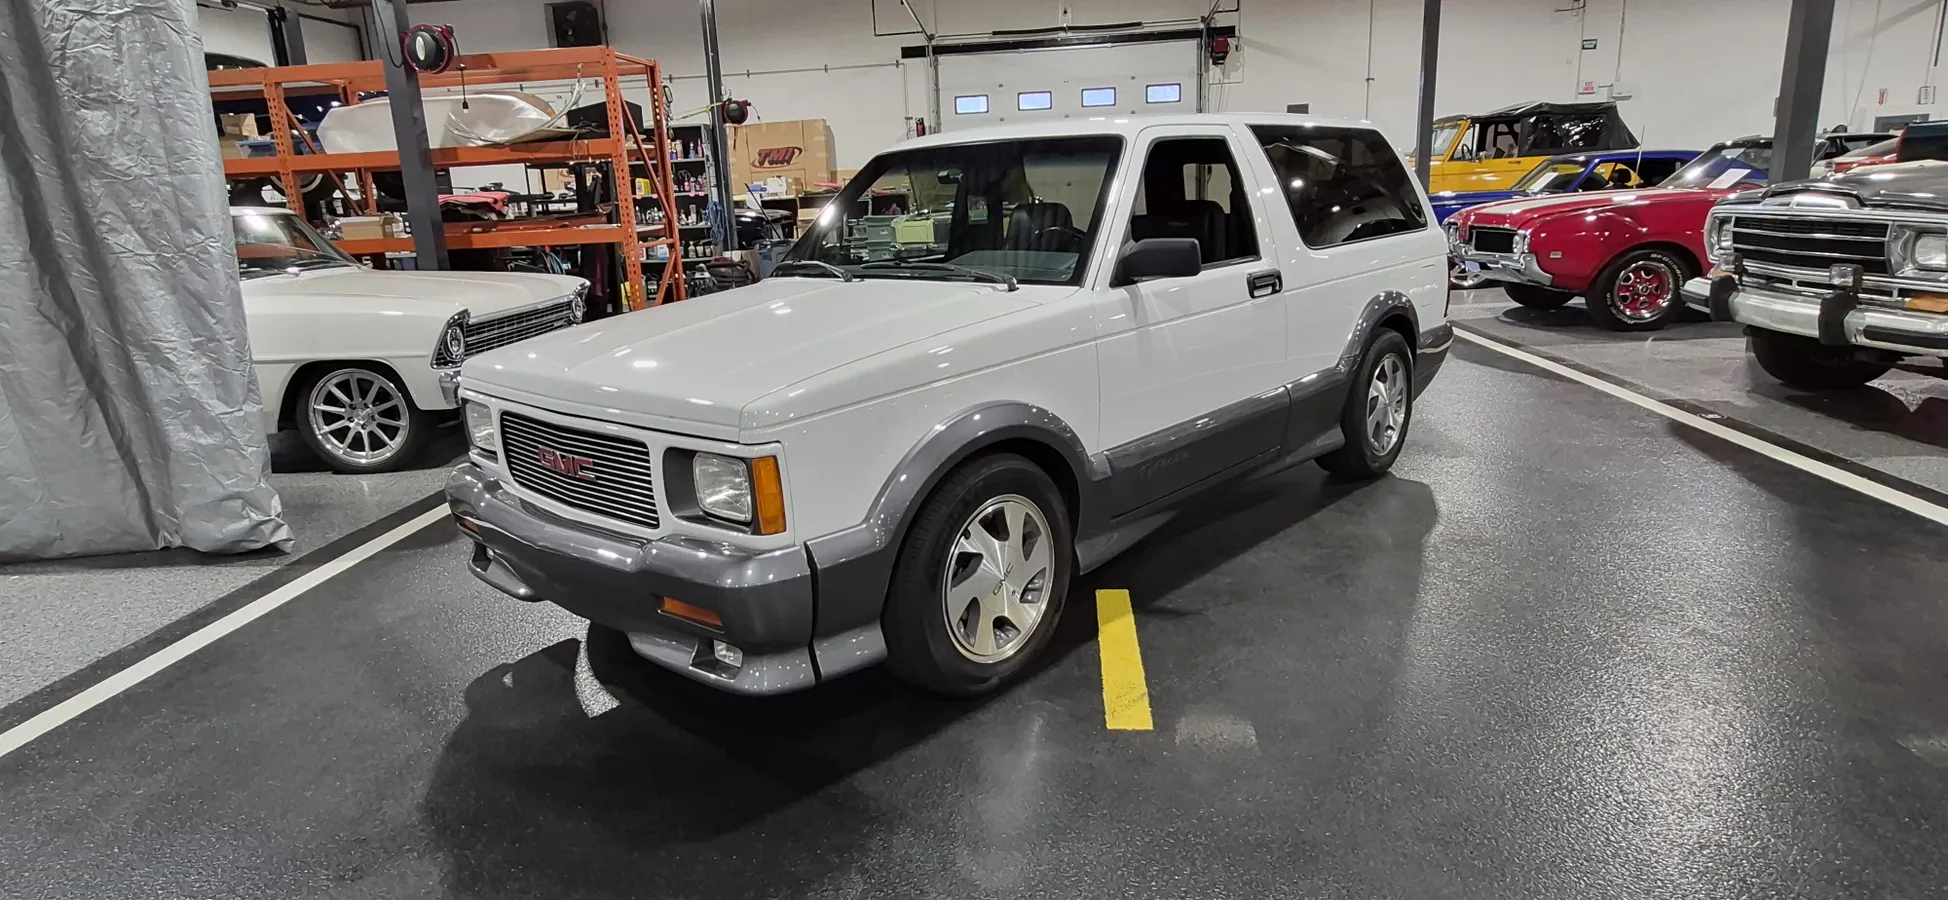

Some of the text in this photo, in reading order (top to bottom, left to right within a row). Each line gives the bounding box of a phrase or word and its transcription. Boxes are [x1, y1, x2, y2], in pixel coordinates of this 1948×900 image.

[757, 147, 796, 166] TMI
[537, 444, 596, 482] GMC
[992, 561, 1014, 596] GMC
